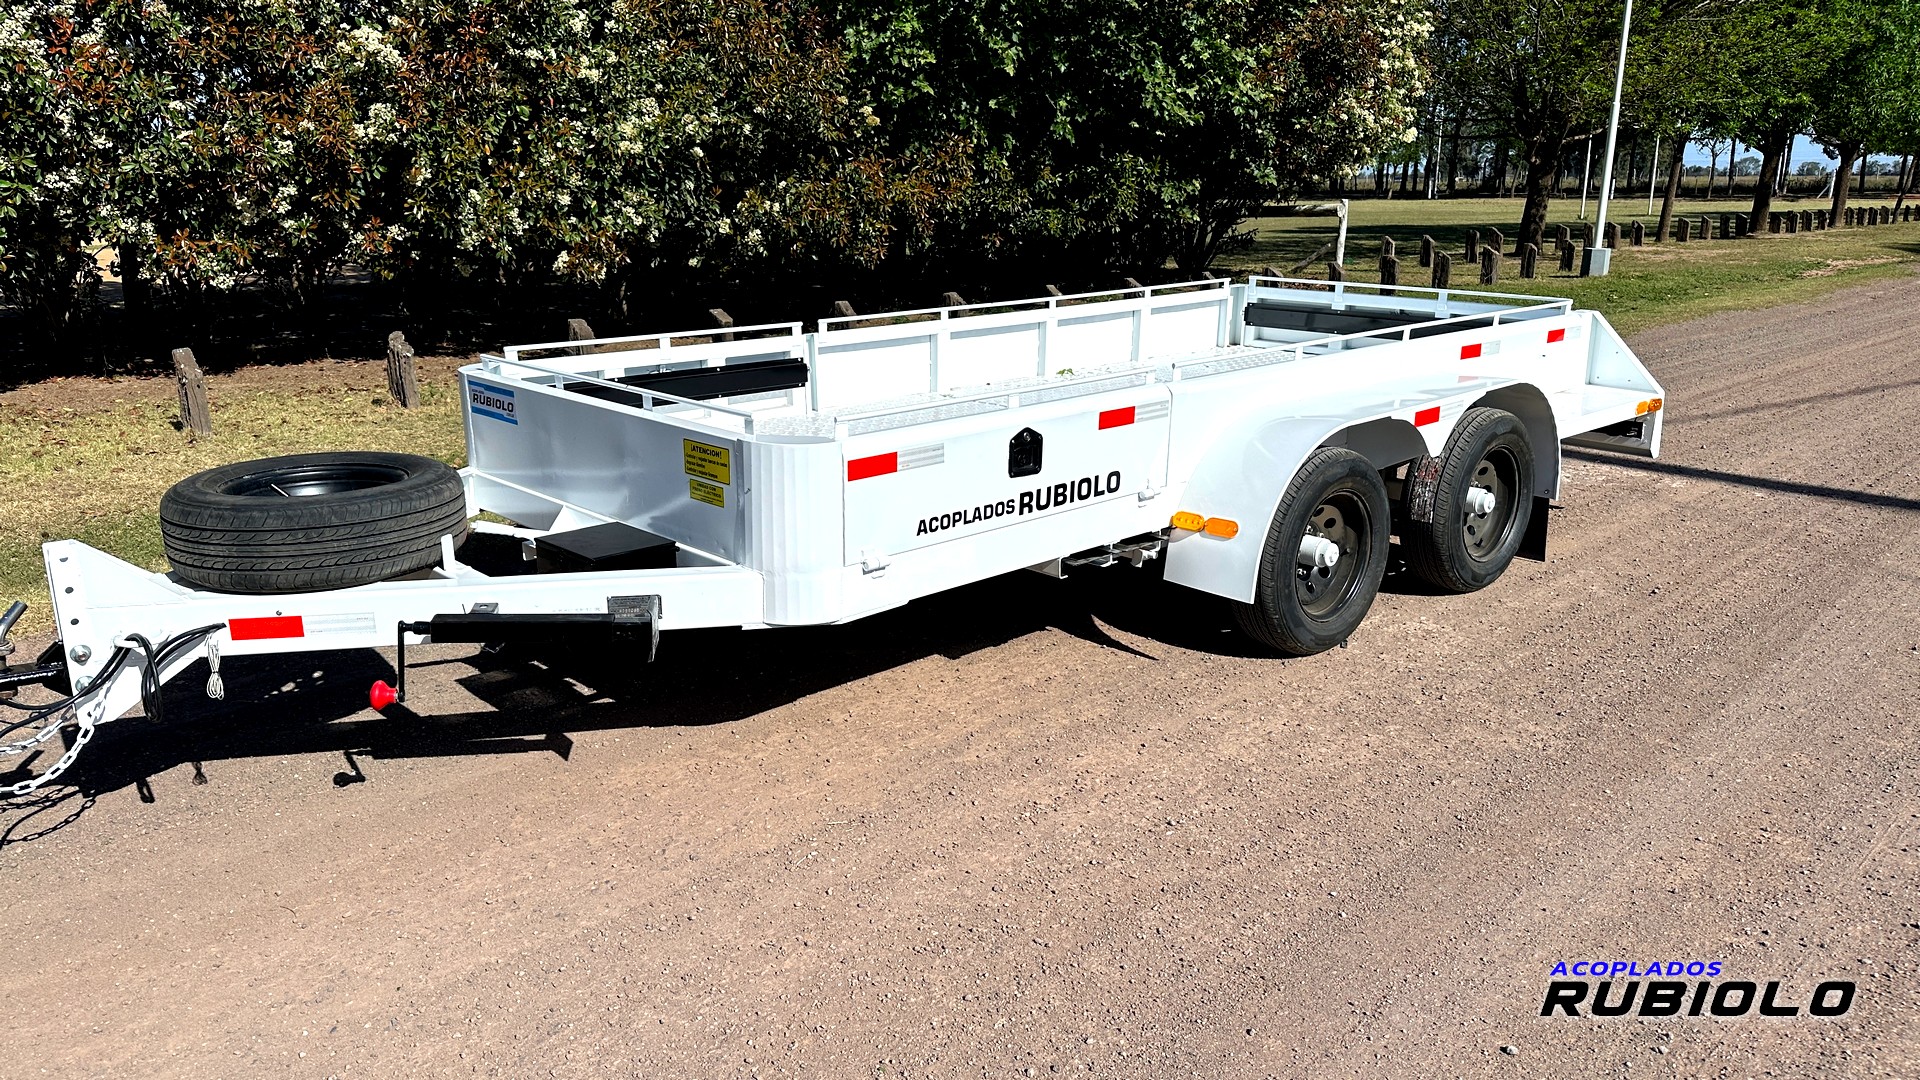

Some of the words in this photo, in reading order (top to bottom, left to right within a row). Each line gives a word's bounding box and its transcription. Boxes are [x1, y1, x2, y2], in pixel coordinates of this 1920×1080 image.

[472, 393, 515, 413] RUBIOLO
[916, 498, 1016, 537] ACOPLADOS
[1018, 470, 1121, 516] RUBIOLO
